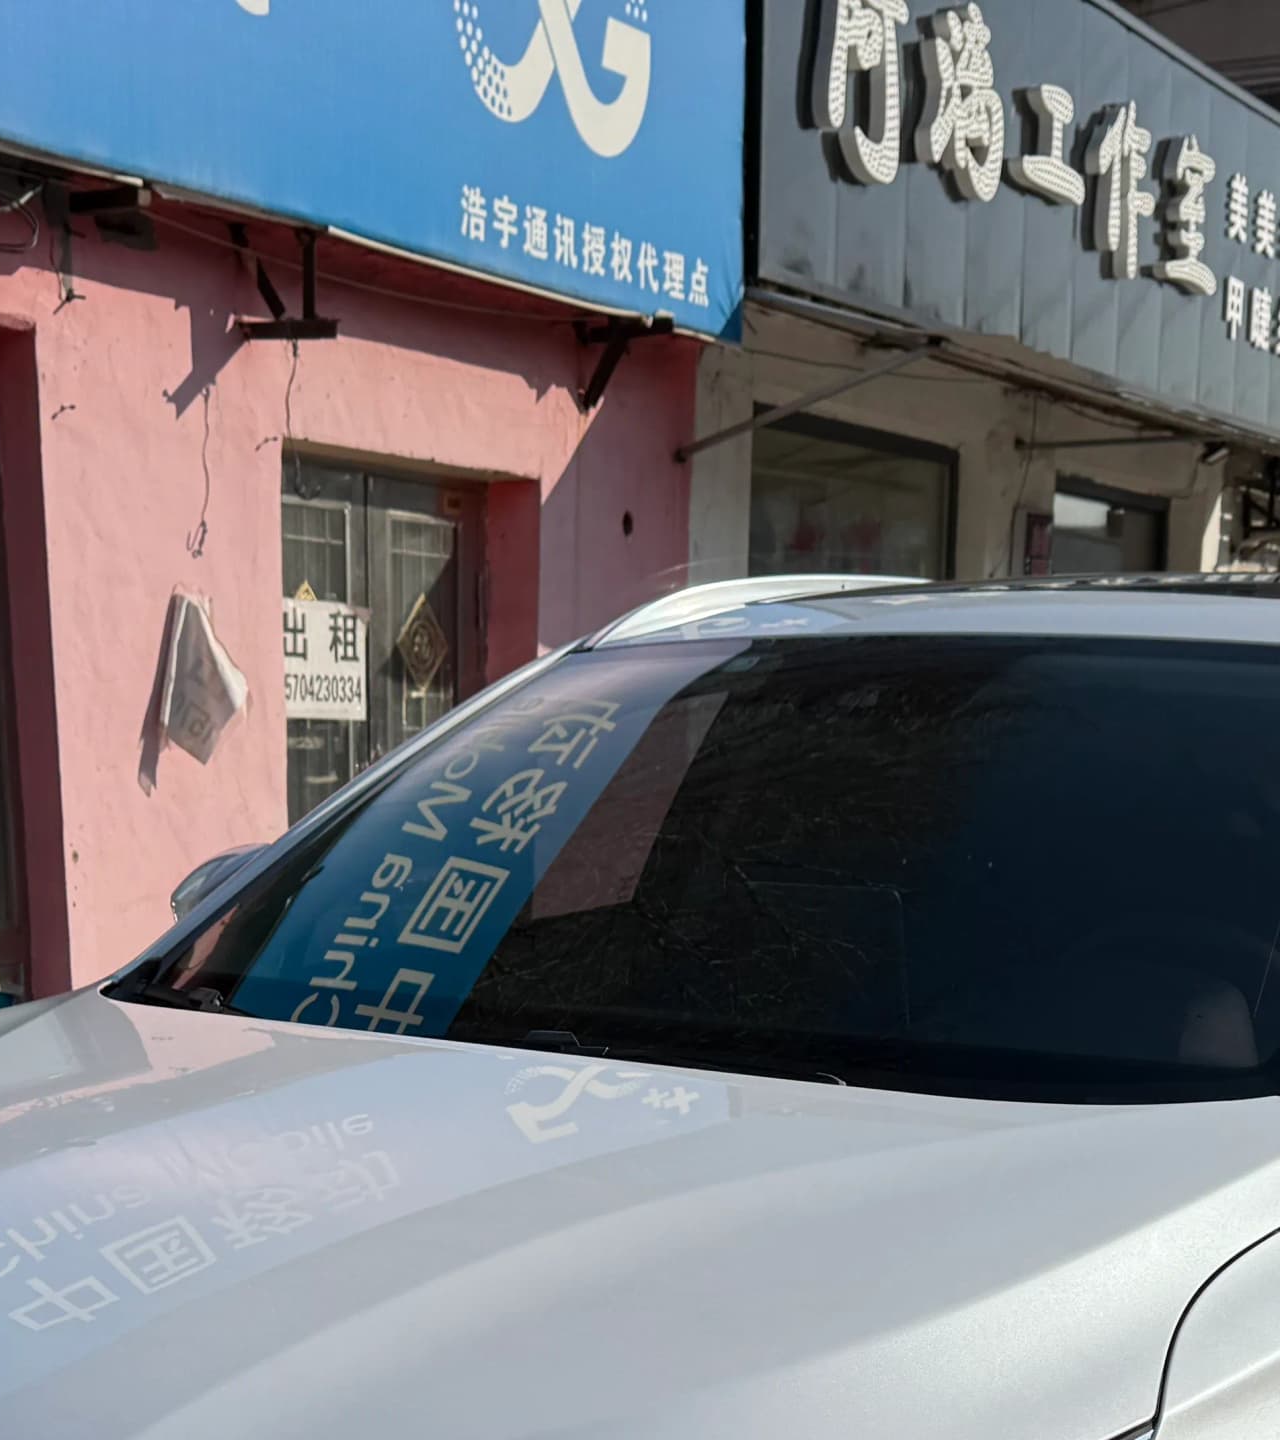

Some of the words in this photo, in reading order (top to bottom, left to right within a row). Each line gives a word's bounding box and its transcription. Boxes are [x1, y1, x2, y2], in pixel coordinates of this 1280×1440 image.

[461, 184, 710, 307] 浩宇通讯授权代理点
[283, 607, 360, 664] 出租
